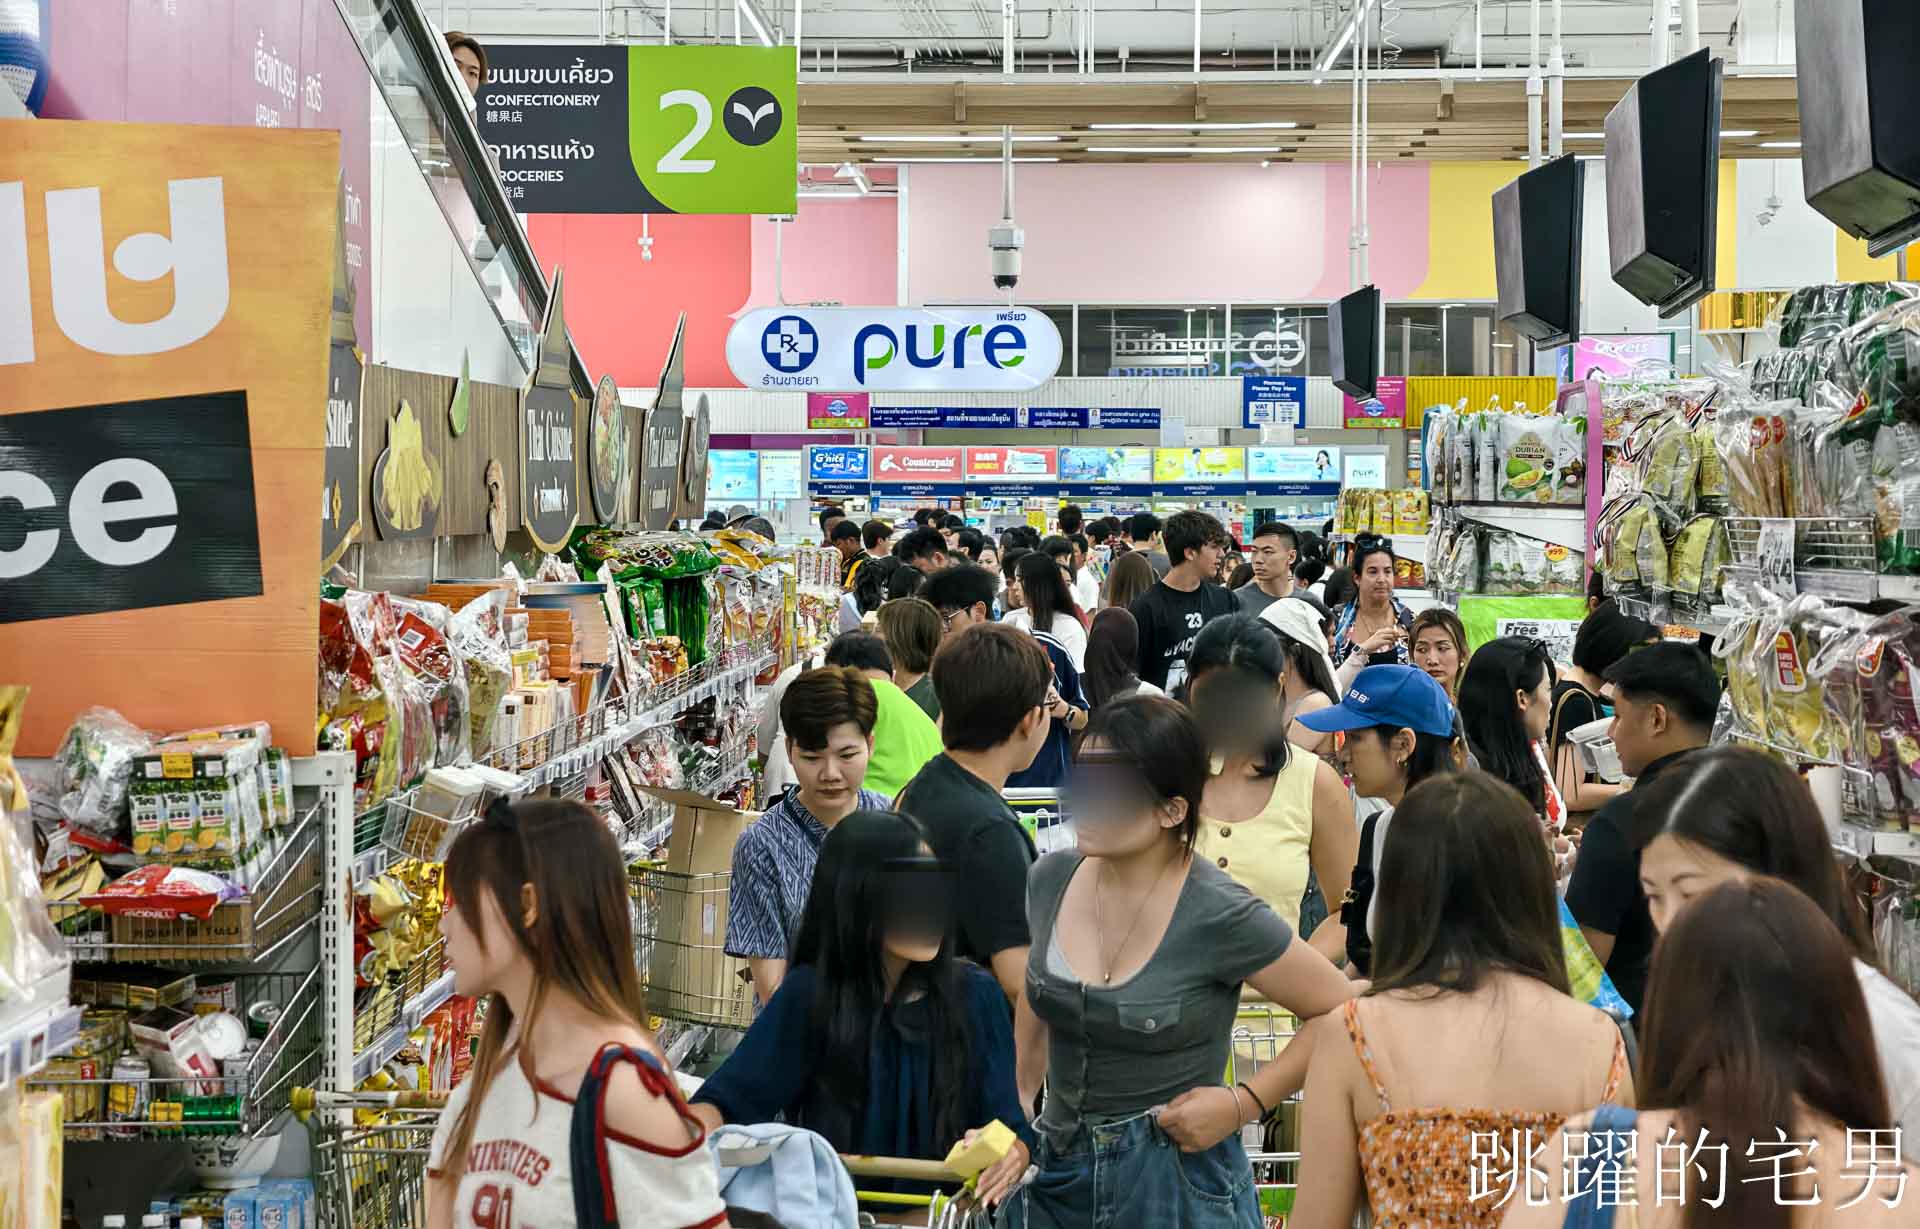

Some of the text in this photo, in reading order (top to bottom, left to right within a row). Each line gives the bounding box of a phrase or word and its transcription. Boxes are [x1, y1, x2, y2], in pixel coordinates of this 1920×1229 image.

[486, 57, 614, 84] ขนมขบเคี้ยว
[485, 94, 600, 106] CONFECTIONERY
[486, 110, 523, 123] 糖果店
[656, 89, 716, 173] 2
[500, 171, 564, 182] ROCERIES
[996, 310, 1027, 322] เพรียว
[781, 334, 799, 353] Rx
[854, 324, 1026, 385] pure
[761, 373, 819, 385] ร้านขายยา
[527, 408, 573, 462] Thai Cuisine
[1185, 612, 1203, 629] 23
[1504, 622, 1539, 636] Free
[464, 1139, 550, 1187] NINETIES
